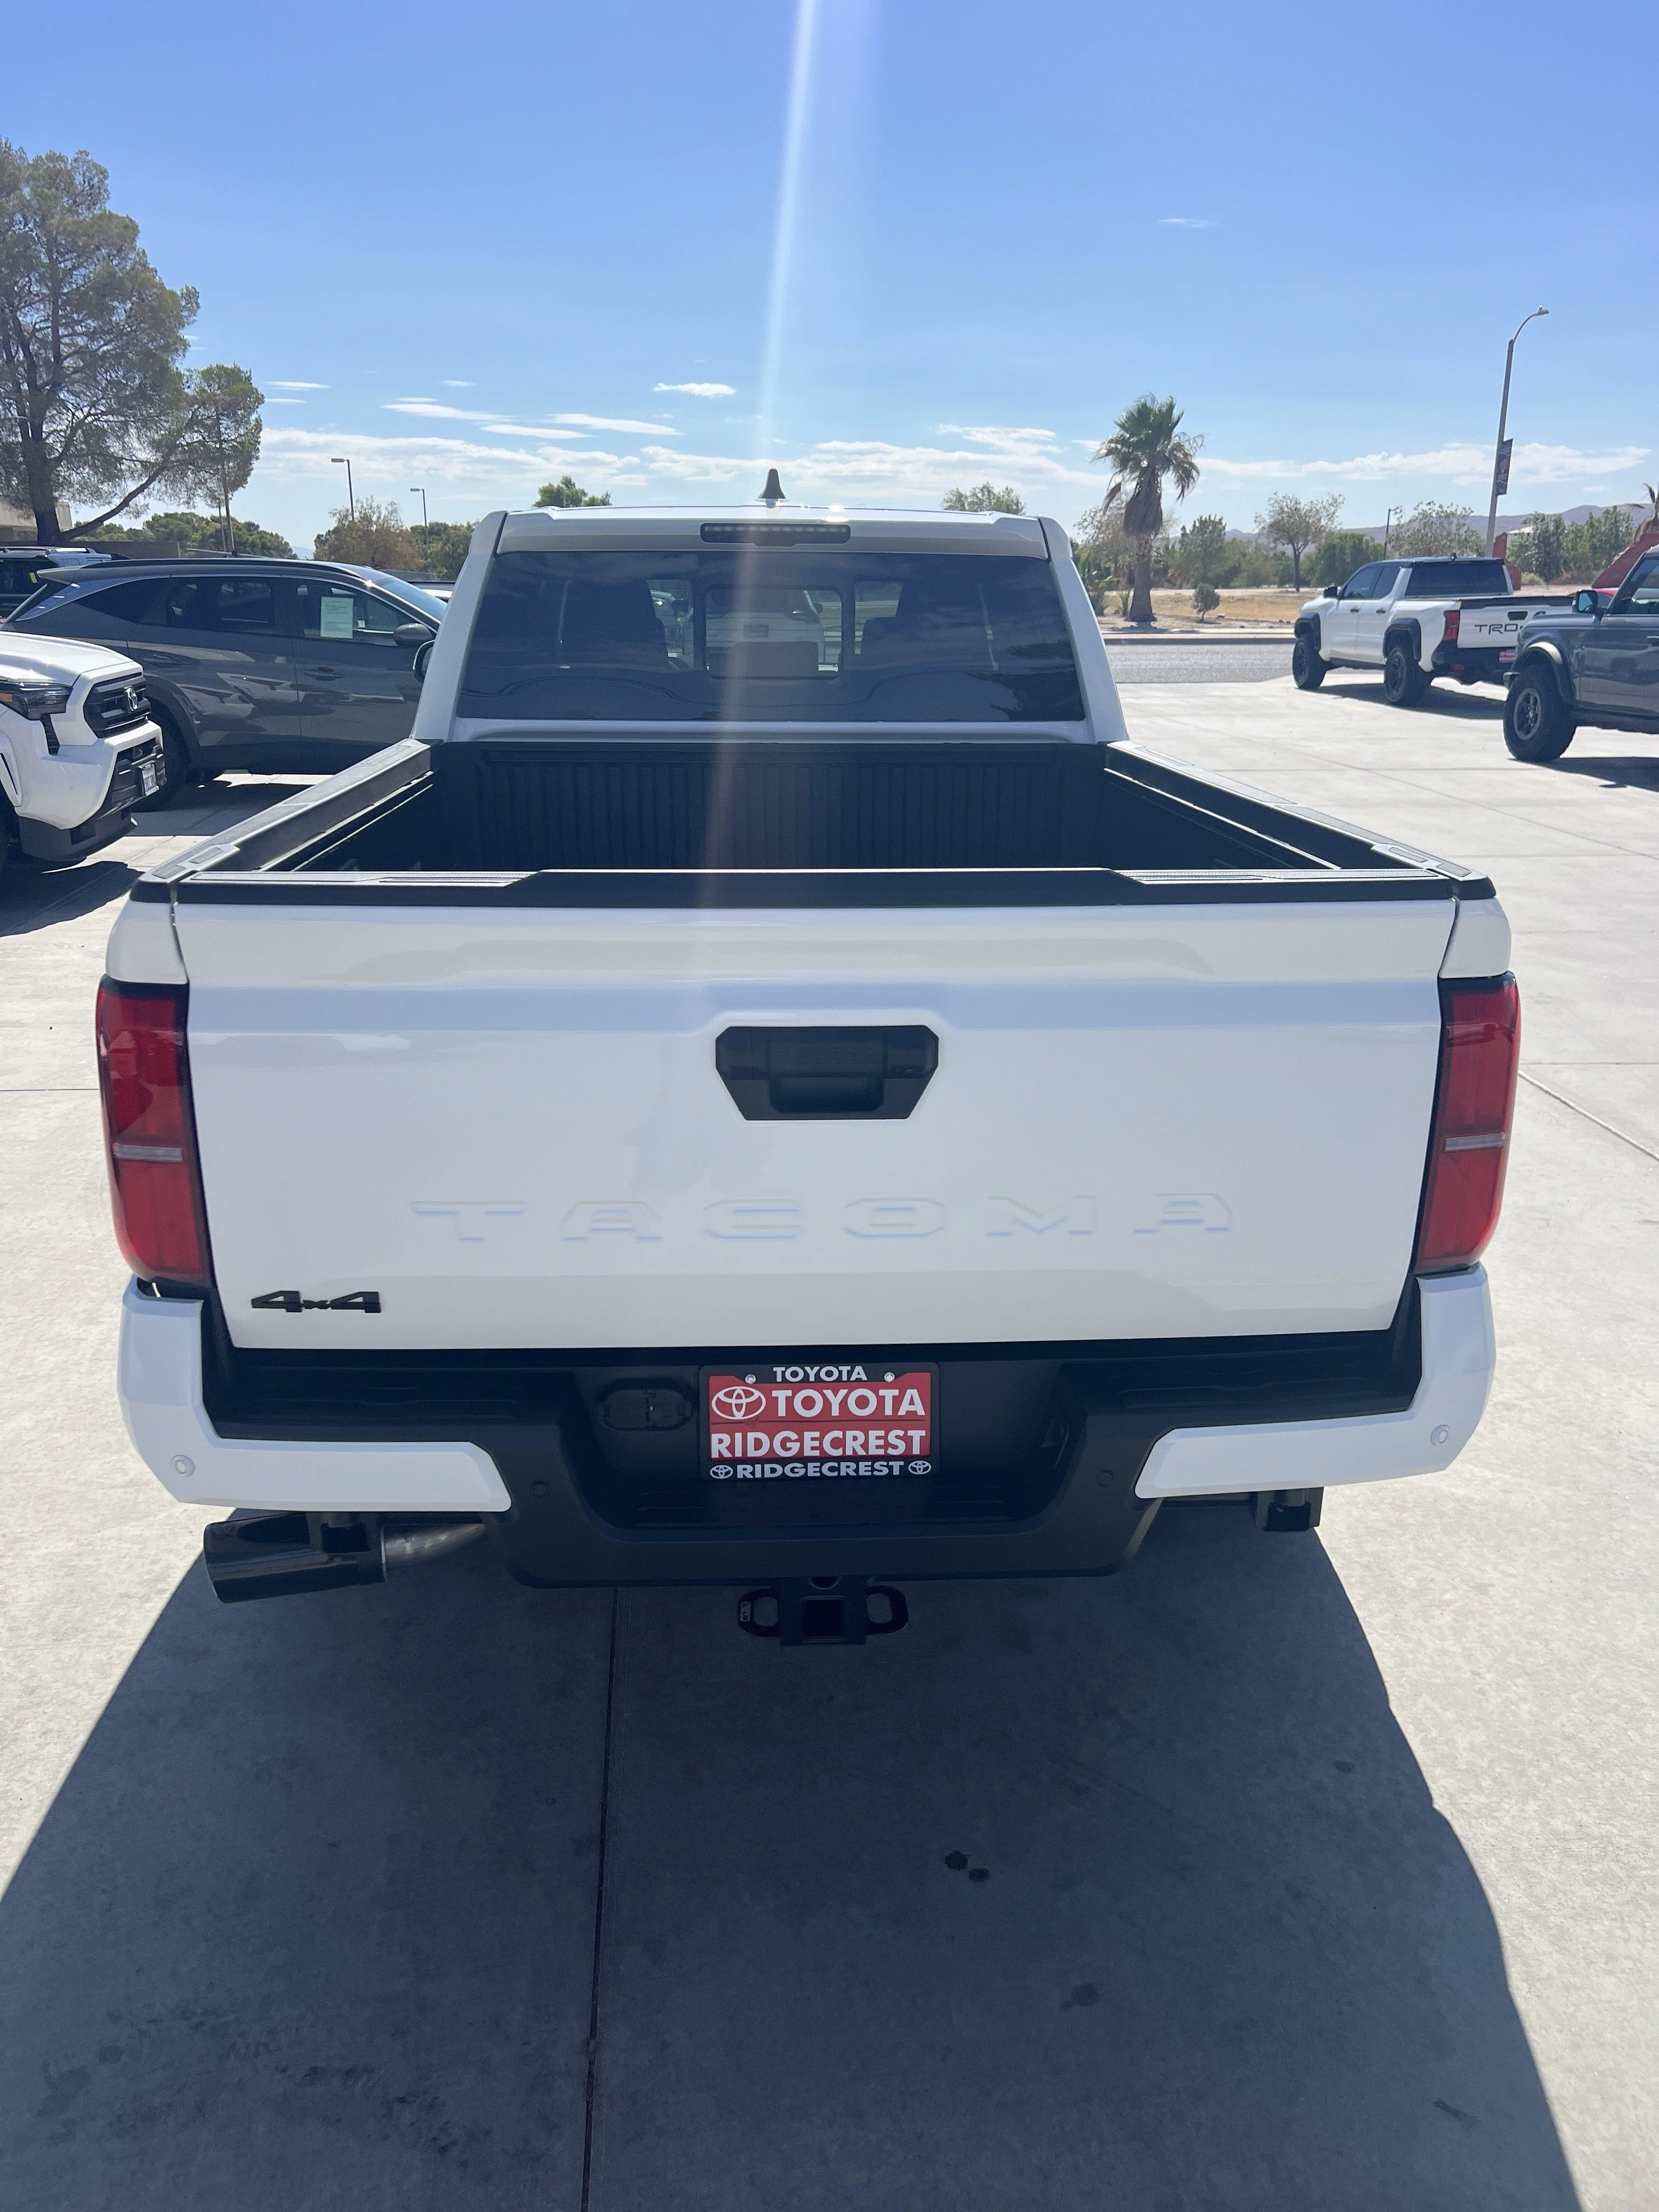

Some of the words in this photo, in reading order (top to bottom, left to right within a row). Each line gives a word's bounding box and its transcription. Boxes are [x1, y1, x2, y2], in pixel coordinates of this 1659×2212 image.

[1474, 623, 1519, 635] TRD
[408, 1192, 1234, 1242] TACOMA
[251, 1290, 381, 1313] 4x4
[772, 1365, 867, 1383] TOYOTA
[771, 1389, 926, 1418] TOYOTA
[711, 1430, 926, 1459] RIDGECREST
[737, 1461, 904, 1479] RIDGECREST
